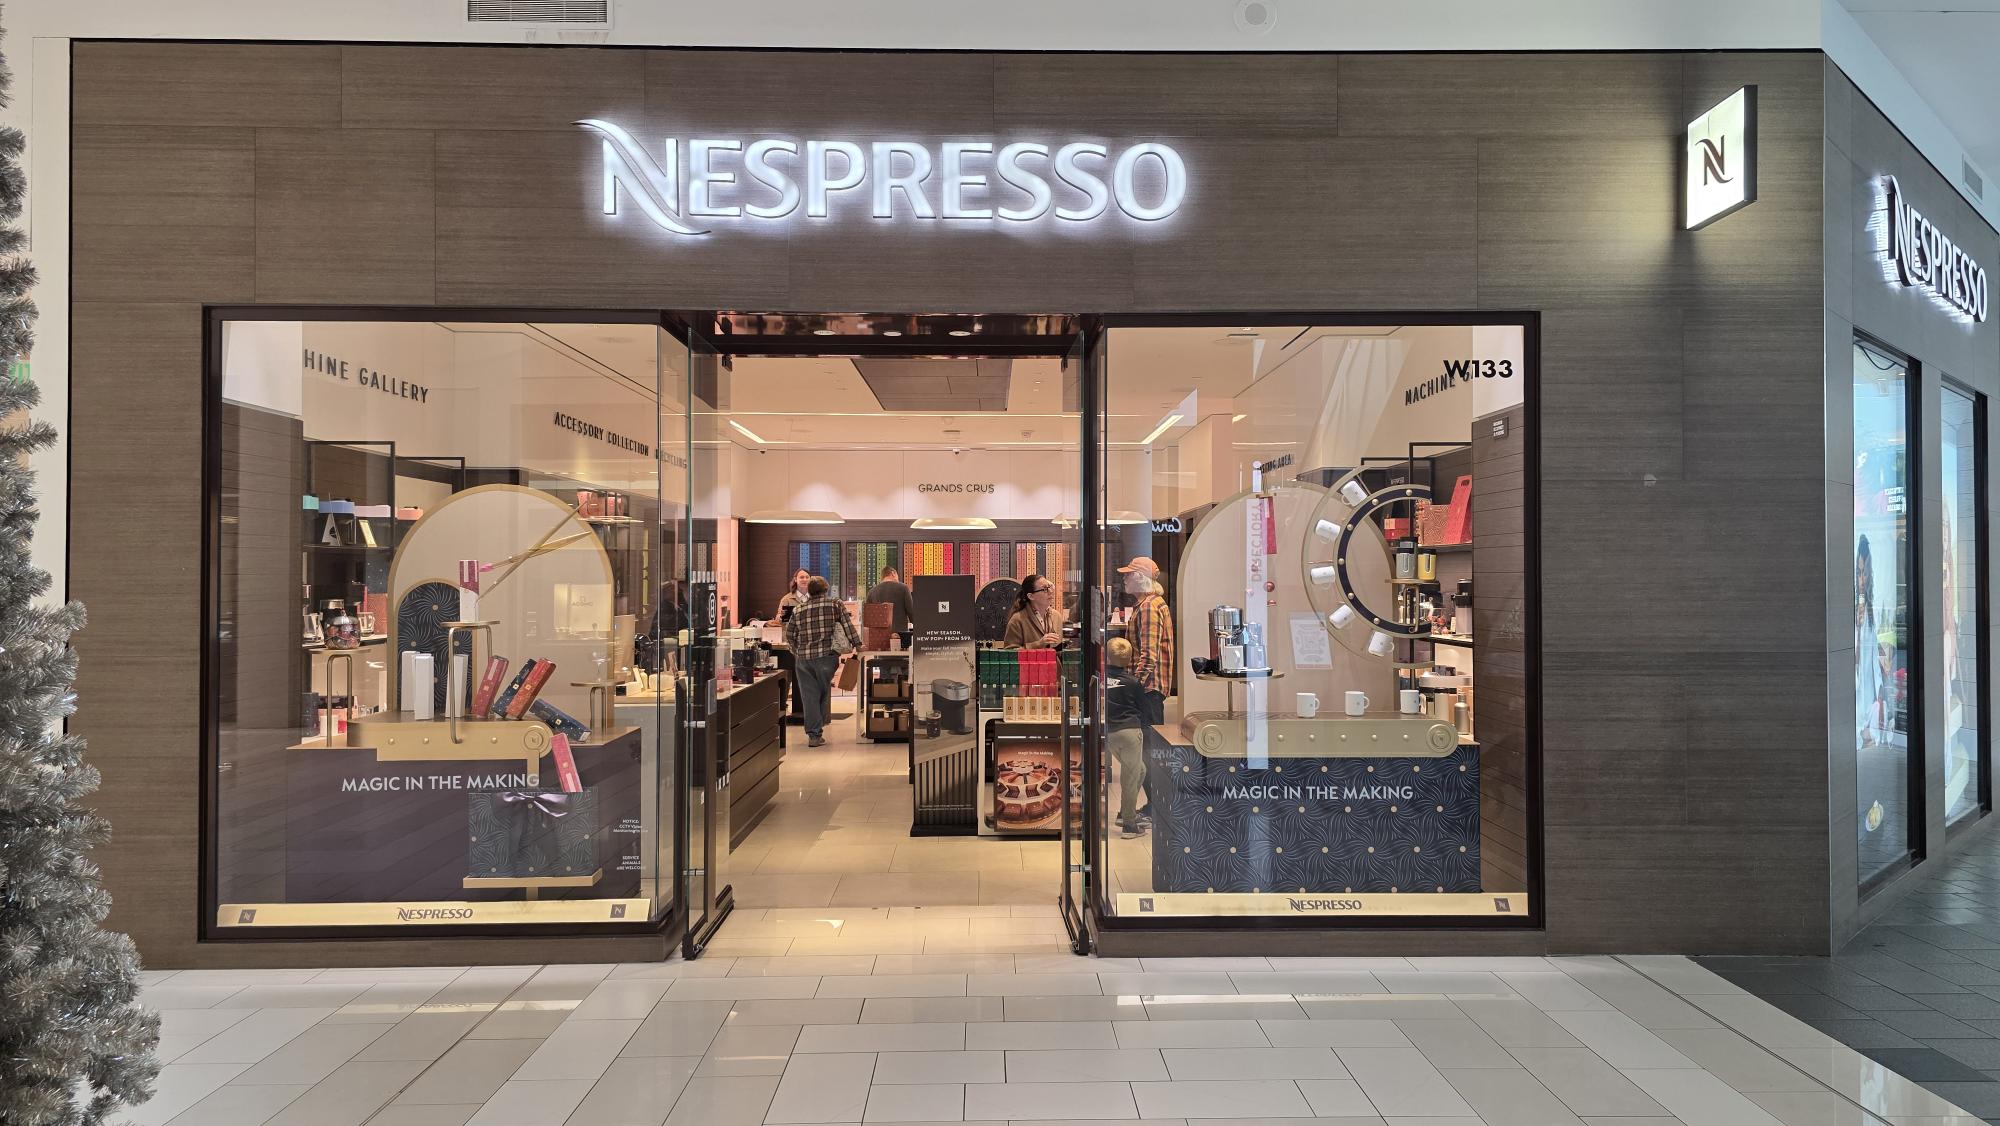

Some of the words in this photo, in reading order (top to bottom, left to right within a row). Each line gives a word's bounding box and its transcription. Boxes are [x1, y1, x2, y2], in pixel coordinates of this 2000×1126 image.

[1695, 135, 1733, 186] N
[571, 119, 1188, 235] NESPRESSO
[1881, 175, 1987, 322] NESPRESSO
[1443, 359, 1513, 378] W133
[359, 367, 428, 403] GALLERY
[1405, 372, 1455, 406] MACHINE
[554, 411, 604, 440] ACCESSORY
[607, 431, 649, 456] COLLECTION
[918, 483, 963, 493] GRANDS
[966, 483, 995, 494] CRUS
[341, 777, 400, 792] MAGIC
[405, 776, 423, 791] IN
[428, 775, 462, 790] THE
[467, 773, 540, 789] MAKING
[1223, 786, 1279, 799] MAGIC
[1284, 786, 1301, 799] IN
[1306, 786, 1339, 800] THE
[1343, 786, 1413, 800] MAKING
[397, 907, 473, 921] NESPRESSO
[1286, 898, 1362, 912] NESPRESSO
